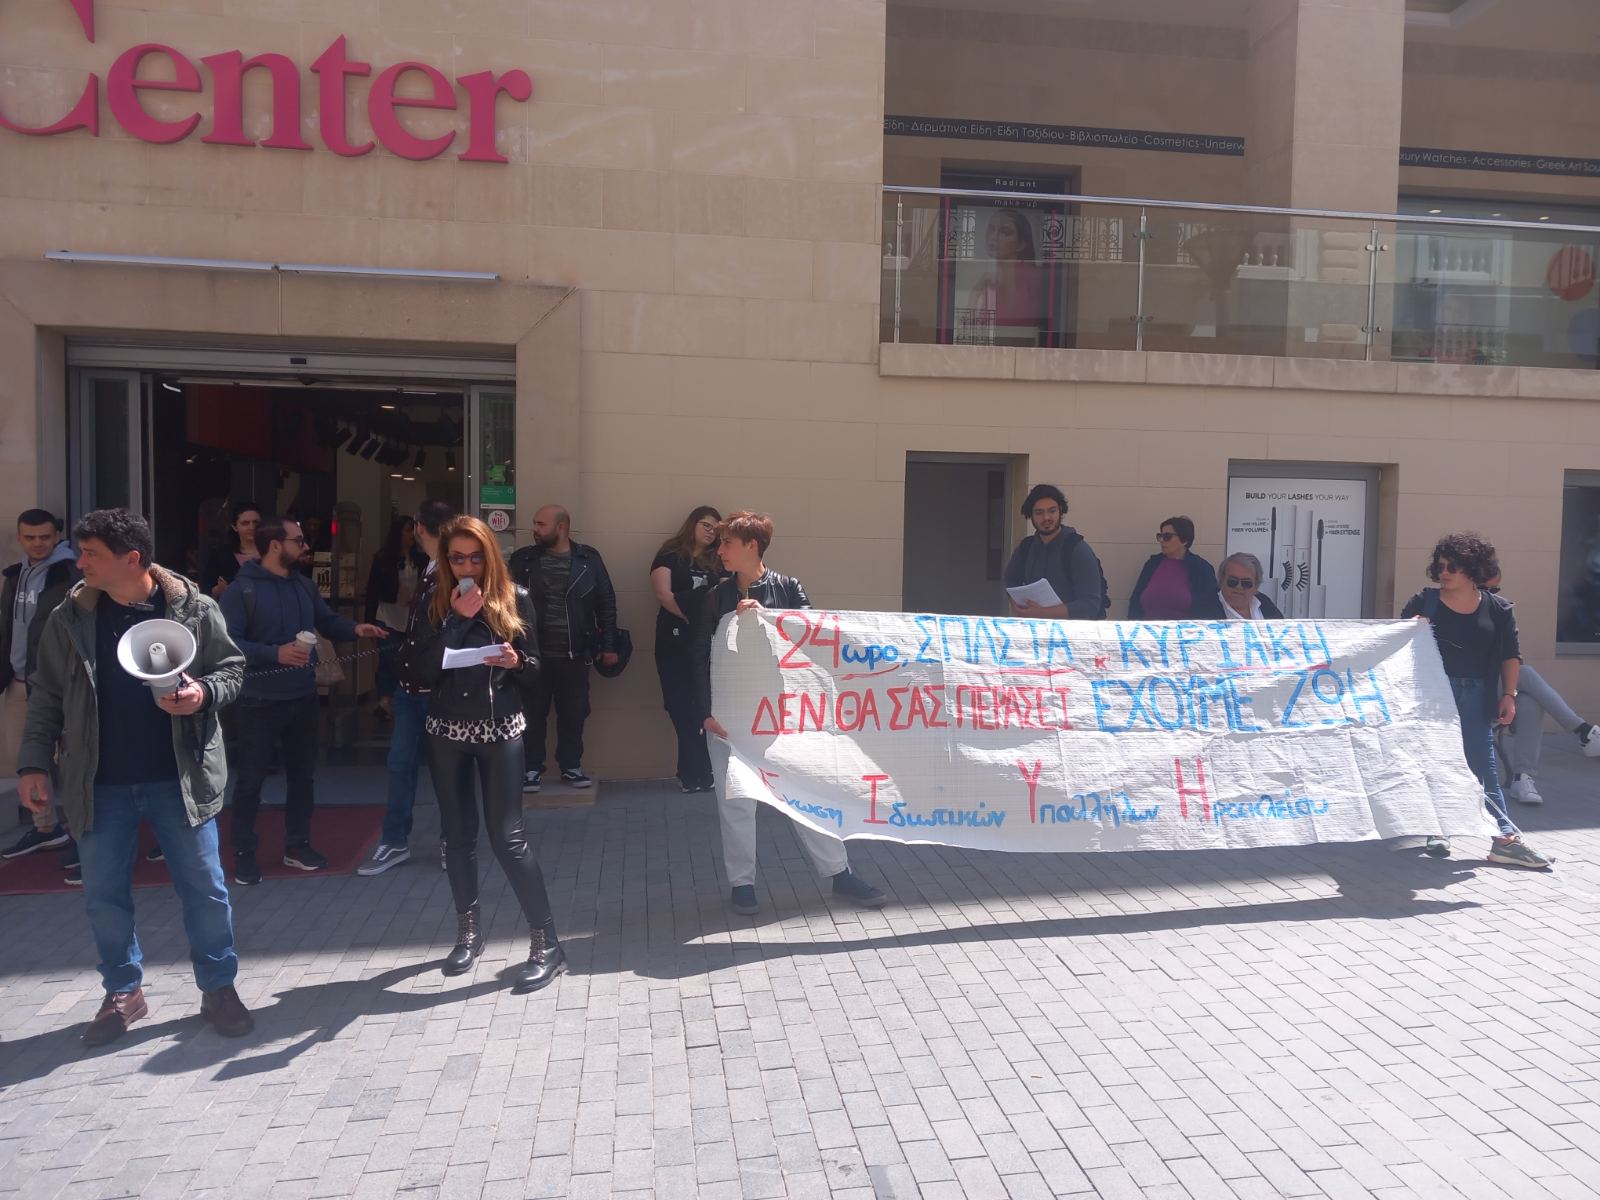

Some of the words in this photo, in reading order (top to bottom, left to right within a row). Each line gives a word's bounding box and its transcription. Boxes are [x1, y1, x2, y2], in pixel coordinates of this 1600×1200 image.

[995, 178, 1036, 188] Radiant
[1245, 492, 1266, 500] BUILD
[1268, 492, 1286, 500] YOUR
[1315, 493, 1333, 501] YOUR
[914, 615, 1074, 666] ΣΠΑΣΤΑ
[1115, 622, 1332, 669] ΚΥΡΙΑΚΗ
[751, 692, 826, 735] ΔΕΝ
[835, 688, 881, 732] ΘΑ
[886, 685, 951, 731] ΣΑΣ
[956, 684, 1074, 731] ΠΕΡΑΣΕΙ
[1091, 672, 1264, 735] ΕΧΟΥΜΕ
